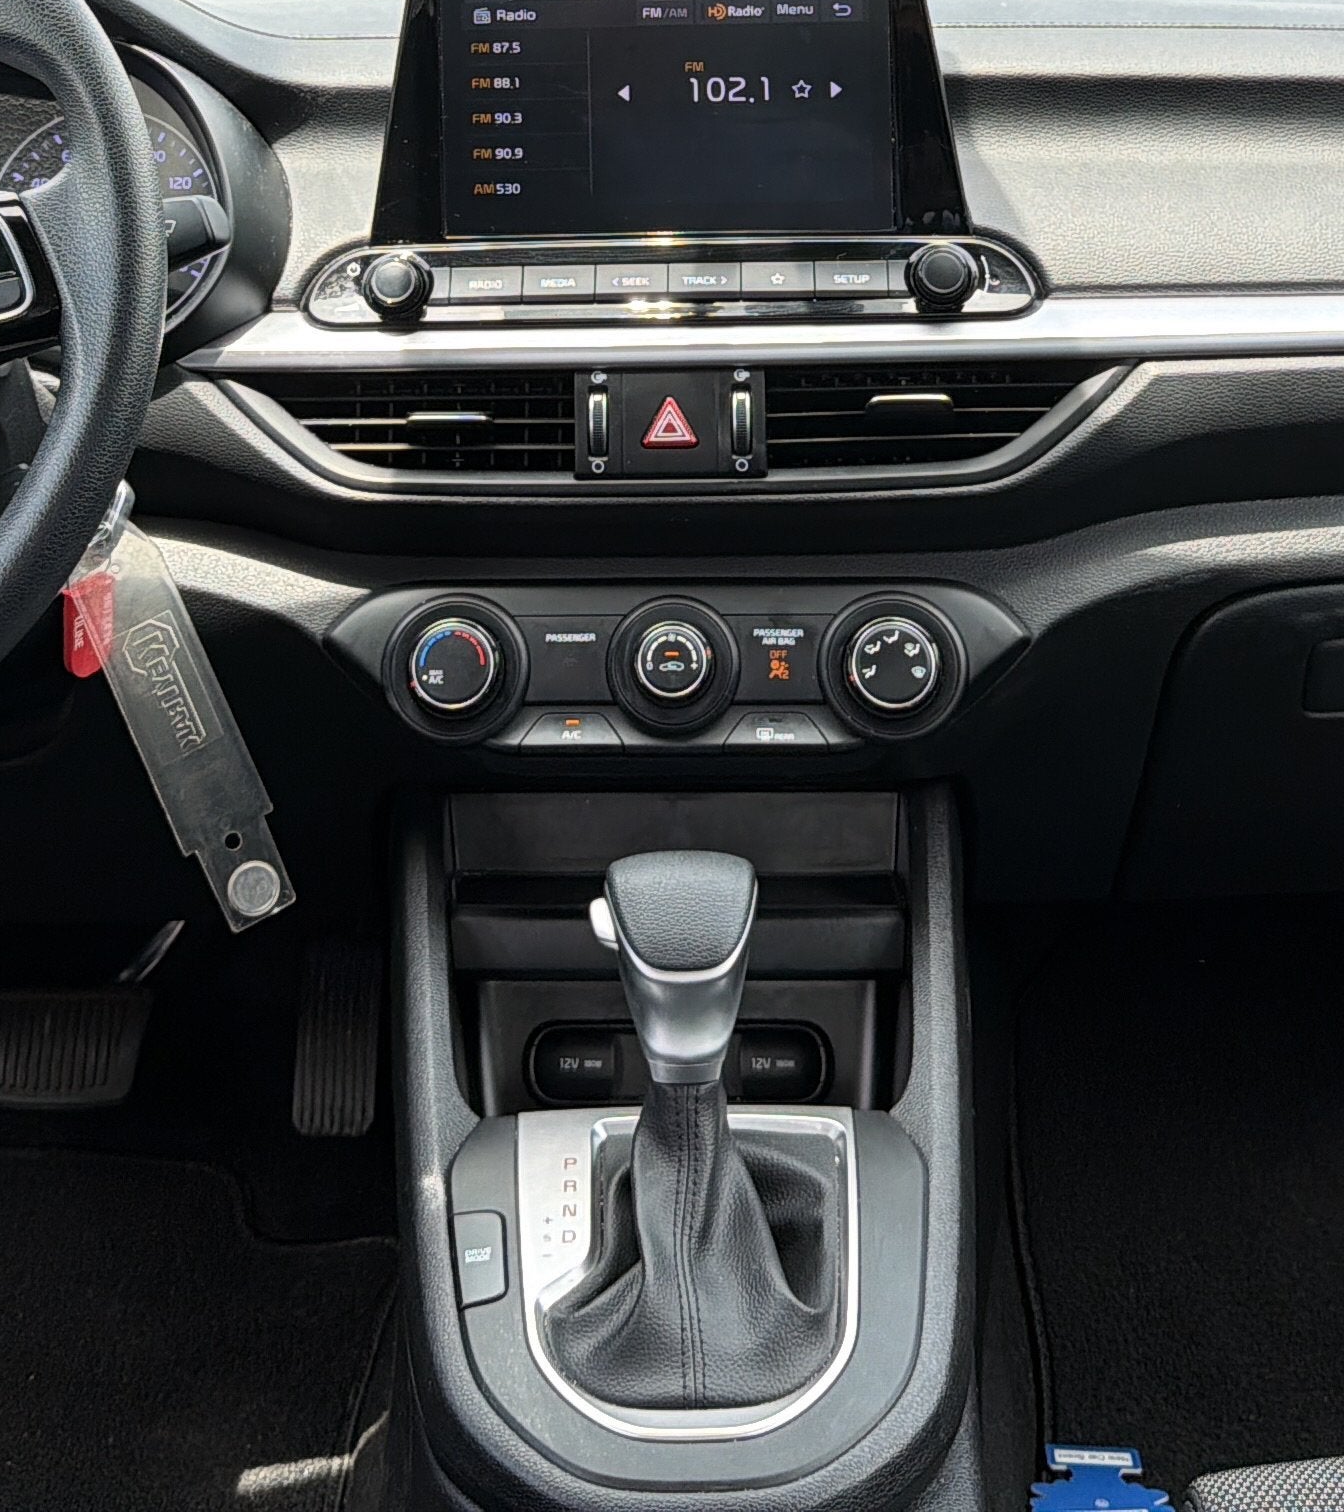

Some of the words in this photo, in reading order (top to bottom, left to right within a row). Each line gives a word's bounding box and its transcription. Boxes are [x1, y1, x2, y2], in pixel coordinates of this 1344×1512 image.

[496, 8, 537, 21] Radio
[776, 3, 814, 16] Menu
[471, 42, 490, 54] FM
[492, 41, 521, 54] 87.5
[684, 61, 704, 73] FM
[471, 77, 490, 89] FM
[493, 76, 520, 89] 88.1
[689, 75, 770, 103] 102.1
[472, 113, 492, 124] FM
[494, 112, 523, 124] 90.3
[473, 148, 492, 160] FM
[494, 147, 523, 160] 90.9
[169, 176, 192, 190] 120
[473, 183, 495, 195] AM
[496, 182, 521, 195] 530
[468, 278, 503, 290] RADIO
[540, 277, 576, 288] MEDIA
[621, 276, 650, 287] SEEK
[682, 275, 717, 286] TRACK
[833, 274, 870, 285] SETUP
[545, 632, 596, 643] PASSENGER
[752, 628, 804, 638] PASSENGER
[761, 637, 777, 646] AIR
[778, 637, 796, 646] BAG
[769, 650, 788, 659] OFF
[428, 675, 444, 684] A/C
[561, 730, 582, 739] A/C
[559, 1057, 579, 1069] 12V
[751, 1057, 771, 1069] 12V
[563, 1157, 577, 1170] P
[563, 1179, 577, 1193] R
[562, 1203, 577, 1217] N
[561, 1229, 577, 1244] D
